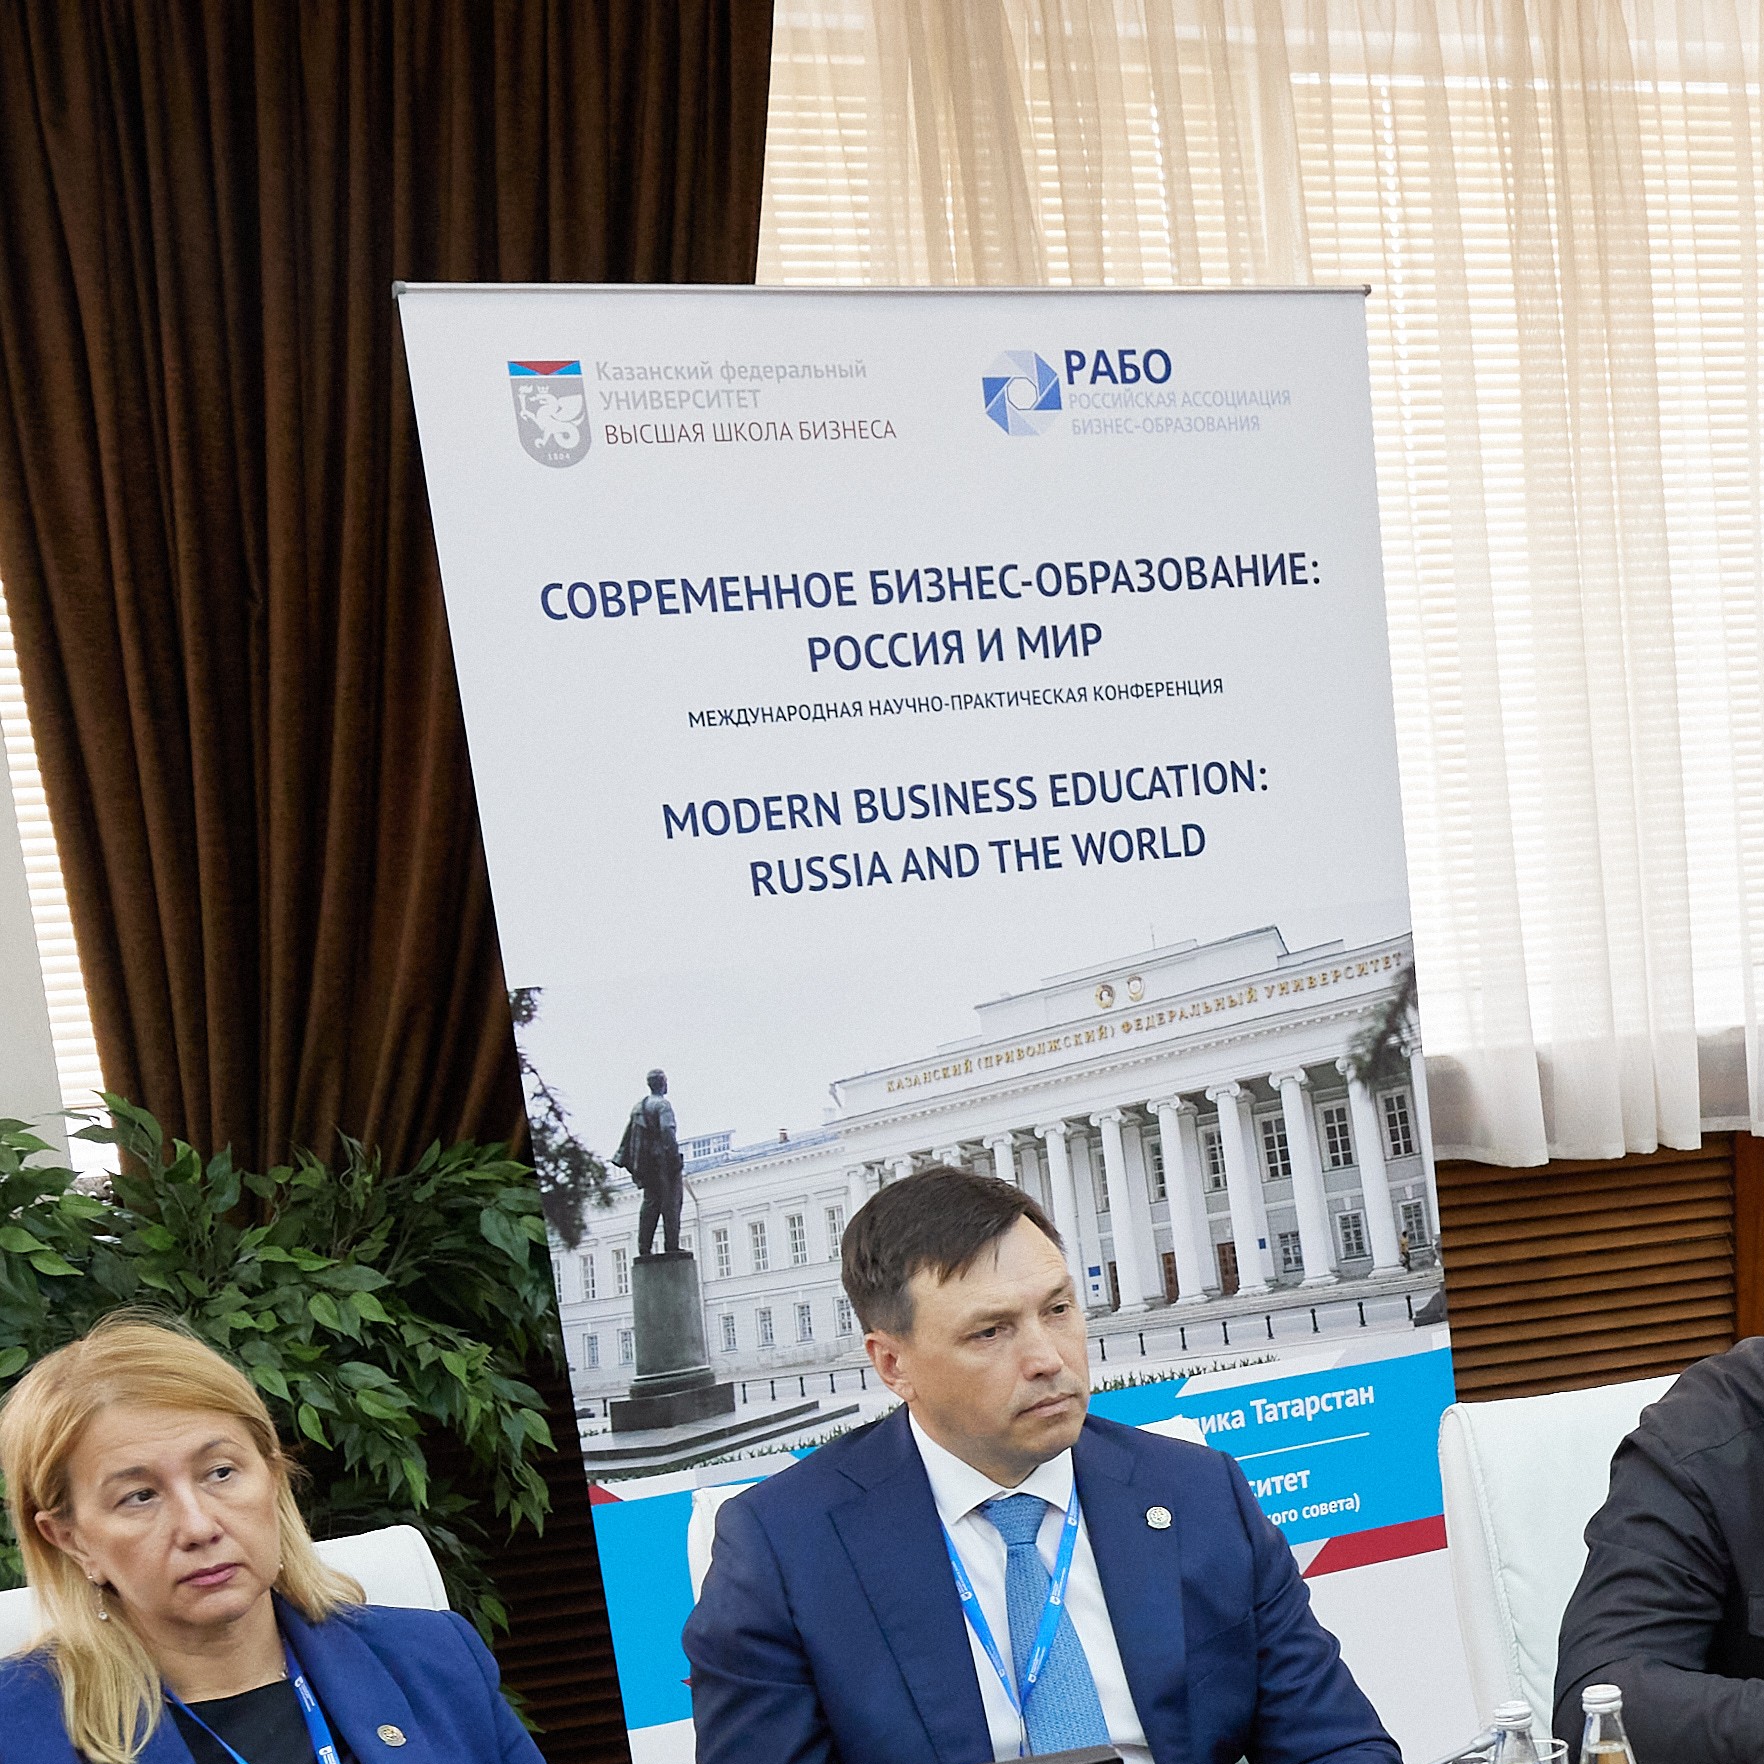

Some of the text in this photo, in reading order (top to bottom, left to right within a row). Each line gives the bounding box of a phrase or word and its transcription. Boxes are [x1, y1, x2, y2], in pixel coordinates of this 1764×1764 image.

[594, 358, 867, 384] Казанский федеральный
[1064, 348, 1172, 385] РАБО
[598, 388, 761, 411] УНИВЕРСИТЕТ
[1067, 386, 1291, 410] РОССИЙСКАЯ АССОЦИАЦИЯ
[603, 418, 897, 445] ВЫСШАЯ ШКОЛА БИЗНЕСА
[1071, 414, 1260, 435] БИЗНЕС-ОБРАЗОВАНИЯ
[540, 551, 1320, 621] СОВРЕМЕННОЕ БИЗНЕС-ОБРАЗОВАНИЕ:
[806, 621, 1102, 672] РОССИЯ И МИР
[687, 676, 1224, 728] МЕЖДУНАРОДНАЯ НАУЧНО-ПРАКТИЧЕСКАЯ КОНФЕРЕНЦИЯ
[661, 758, 1268, 840] MODERN BUSINESS EDUCATION:
[749, 822, 1206, 897] RUSSIA AND THE WORLD
[1249, 1385, 1374, 1424] Татарстан
[1301, 1492, 1360, 1518] совета)
